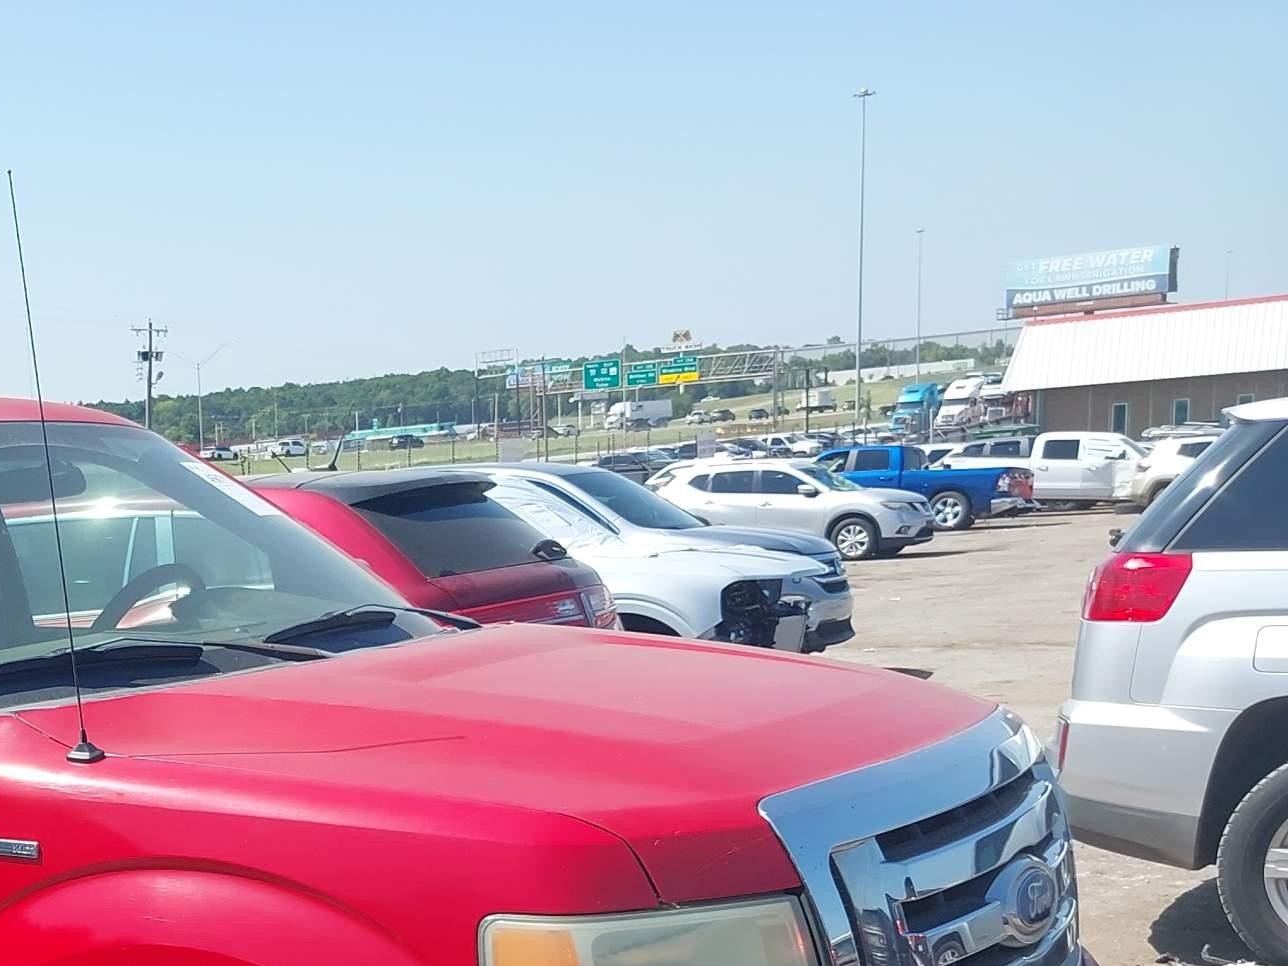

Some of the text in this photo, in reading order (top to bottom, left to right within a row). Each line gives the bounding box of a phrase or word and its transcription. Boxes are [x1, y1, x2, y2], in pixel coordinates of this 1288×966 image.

[1016, 249, 1154, 274] GET FREE WATER
[1047, 271, 1075, 283] LAWN
[1075, 265, 1144, 281] IRRIGATION
[1013, 279, 1157, 305] AQUA WELL DRILLING
[1027, 879, 1051, 920] Ford
